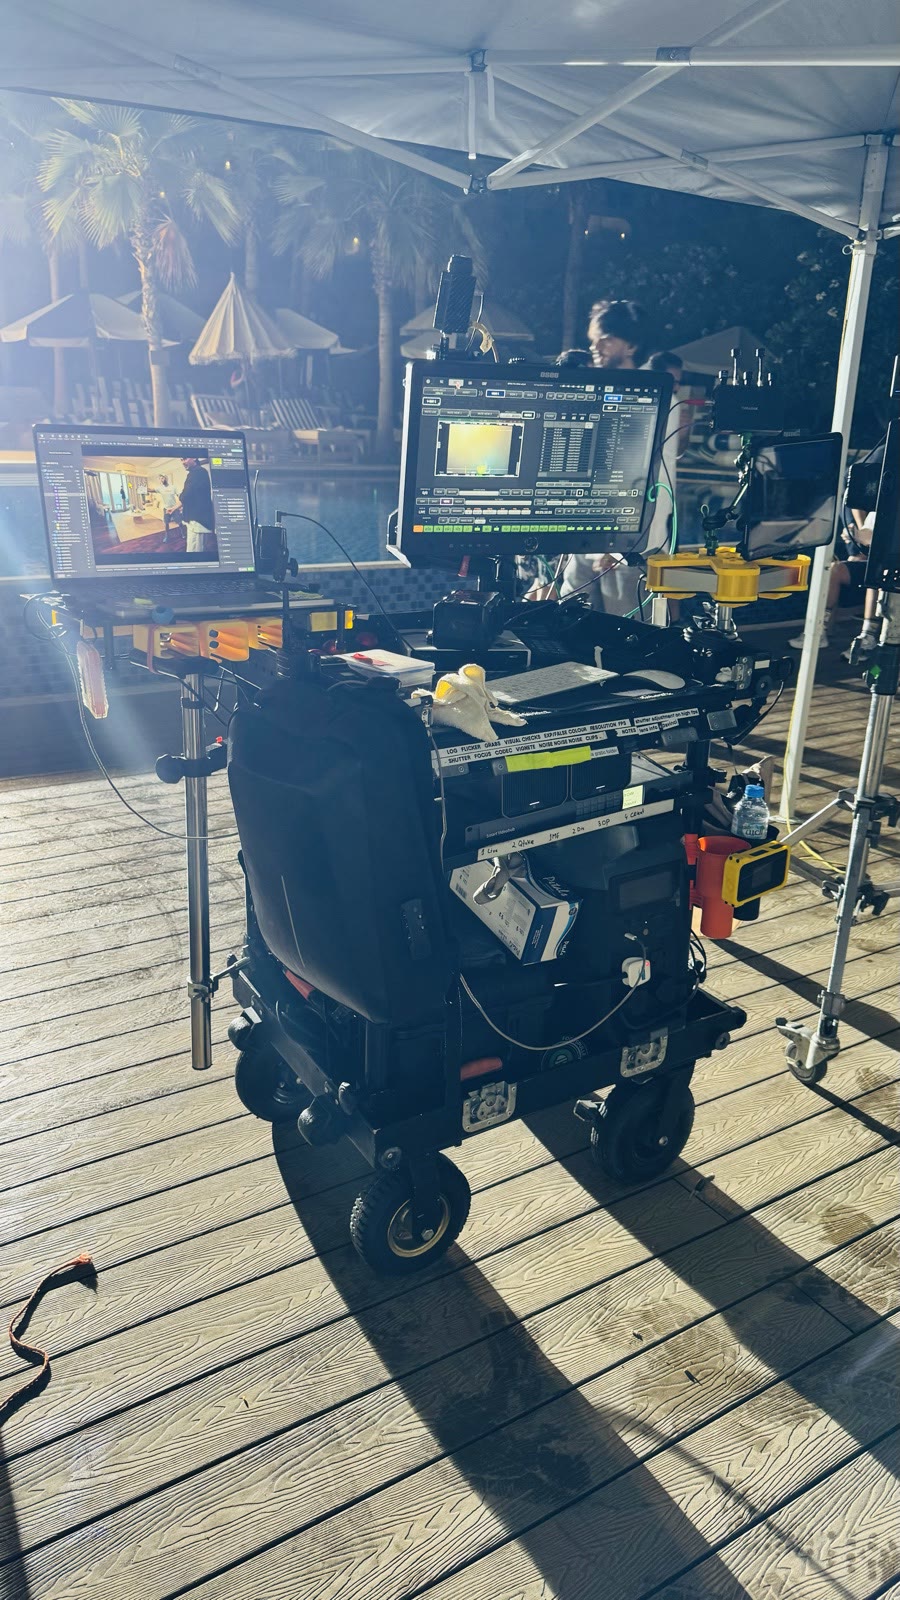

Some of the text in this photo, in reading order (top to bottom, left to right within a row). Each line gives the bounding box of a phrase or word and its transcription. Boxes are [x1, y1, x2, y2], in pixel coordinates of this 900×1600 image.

[461, 744, 481, 752] FLICKER
[504, 737, 521, 745] VISUAL
[521, 734, 541, 742] CHECKS
[543, 730, 568, 739] EXP/FALSE
[589, 722, 617, 730] RESOLUTION
[448, 755, 471, 764] SHUTTER
[474, 751, 492, 759] FOCUS
